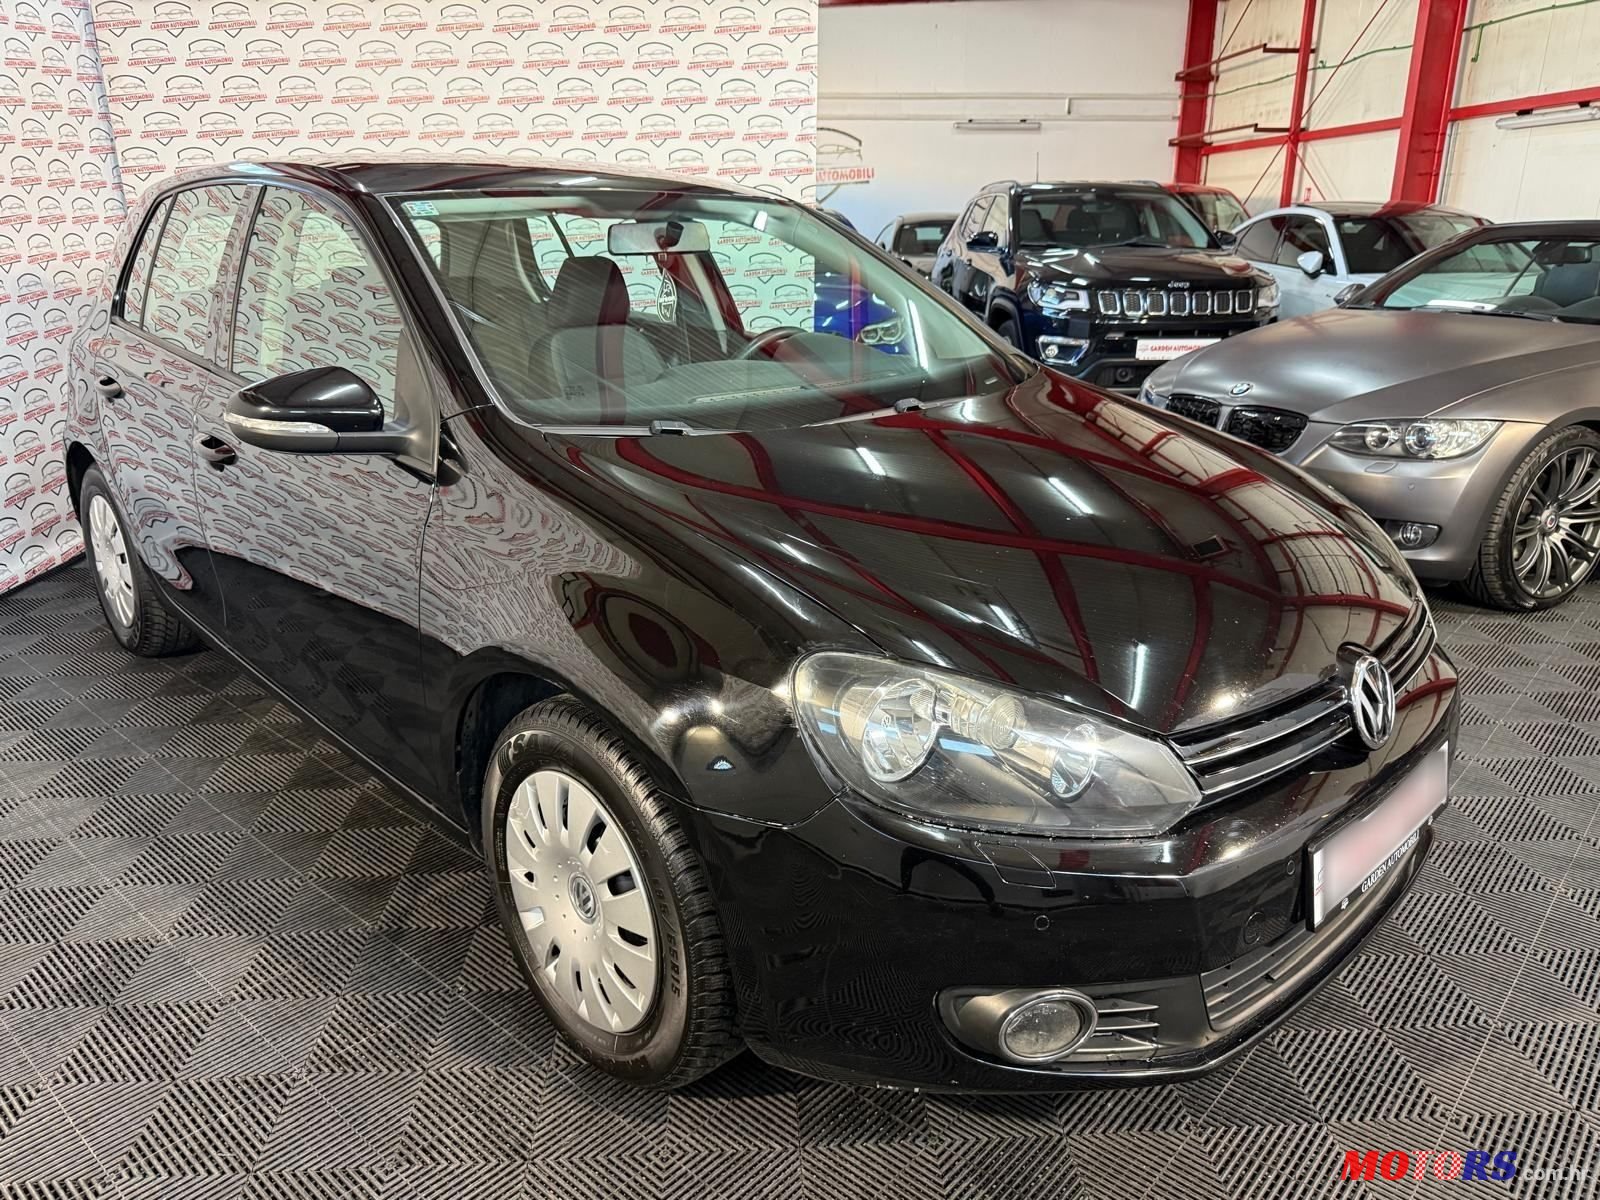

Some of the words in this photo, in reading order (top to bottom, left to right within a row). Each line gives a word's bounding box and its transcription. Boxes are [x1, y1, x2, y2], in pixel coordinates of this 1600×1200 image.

[816, 168, 874, 181] UTOMOBILI
[1361, 864, 1387, 892] GARDEN
[1387, 830, 1420, 870] AUTOMOBILI
